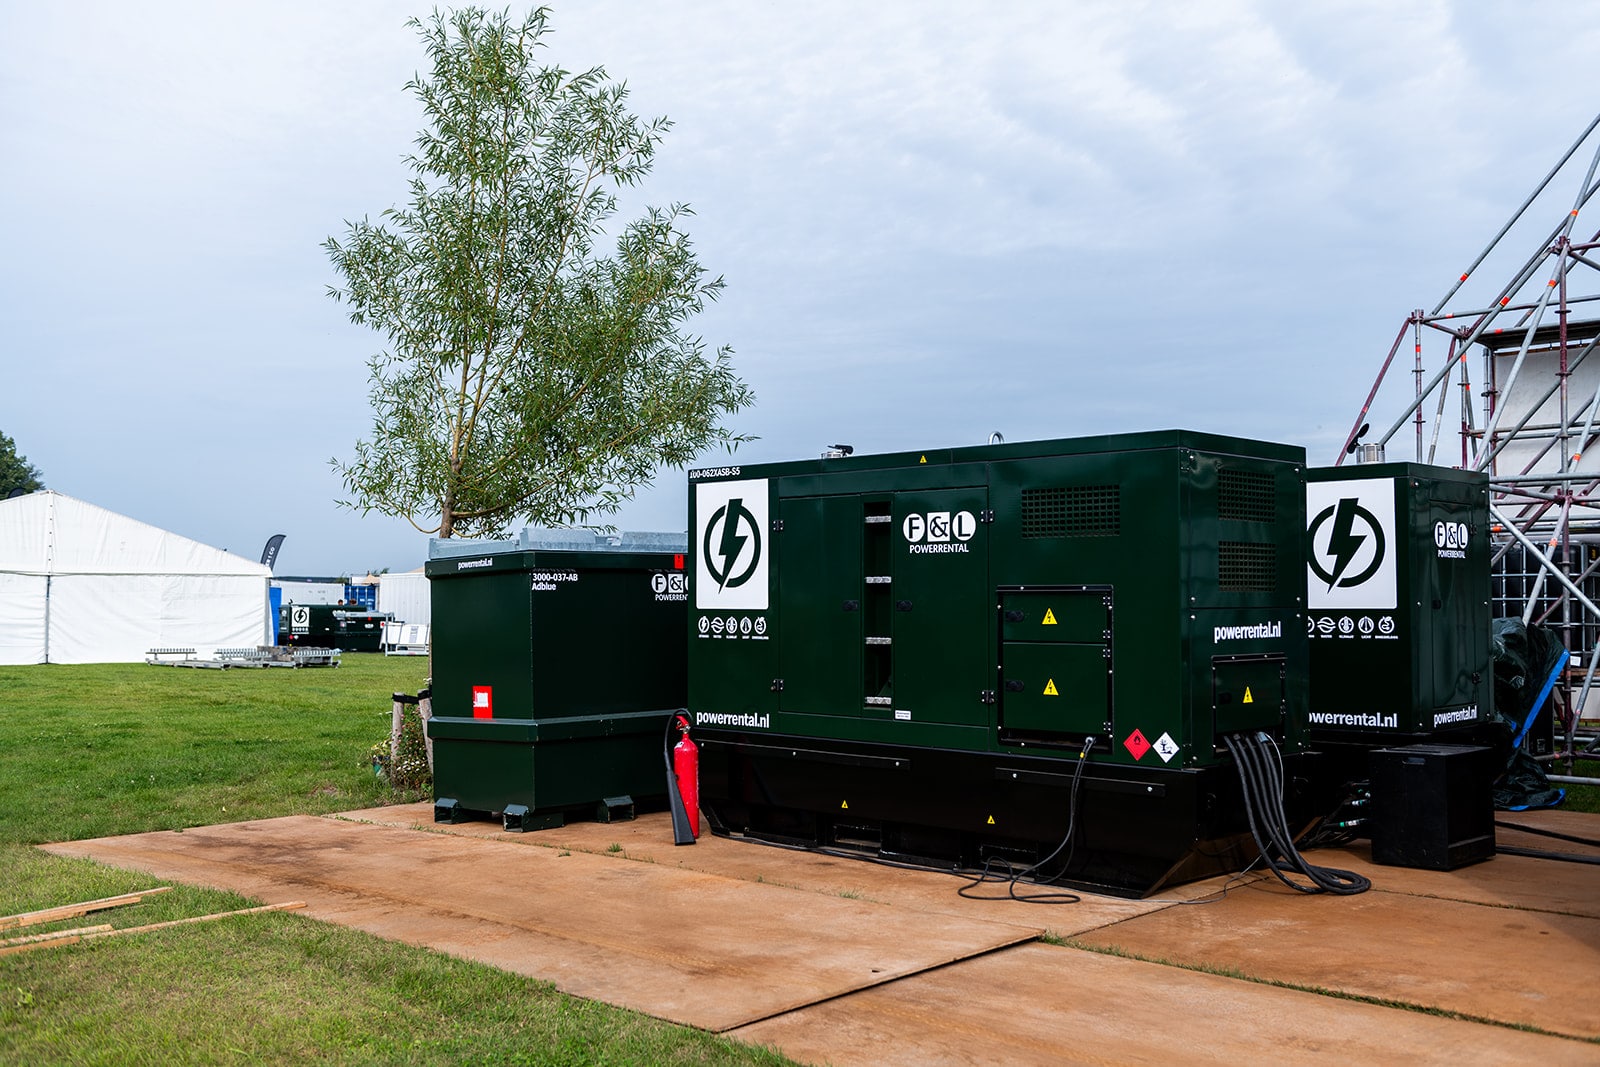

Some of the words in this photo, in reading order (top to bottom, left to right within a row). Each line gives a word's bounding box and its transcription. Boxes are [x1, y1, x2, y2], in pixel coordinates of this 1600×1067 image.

[909, 544, 970, 555] POWERRENTAL
[458, 557, 493, 571] powerrental.nl
[532, 572, 579, 582] 3000-037-AB
[531, 582, 557, 591] Adblue
[1214, 621, 1282, 644] powerrental.nl
[696, 711, 770, 729] powerrental.nl
[1433, 704, 1478, 728] powerrental.nl
